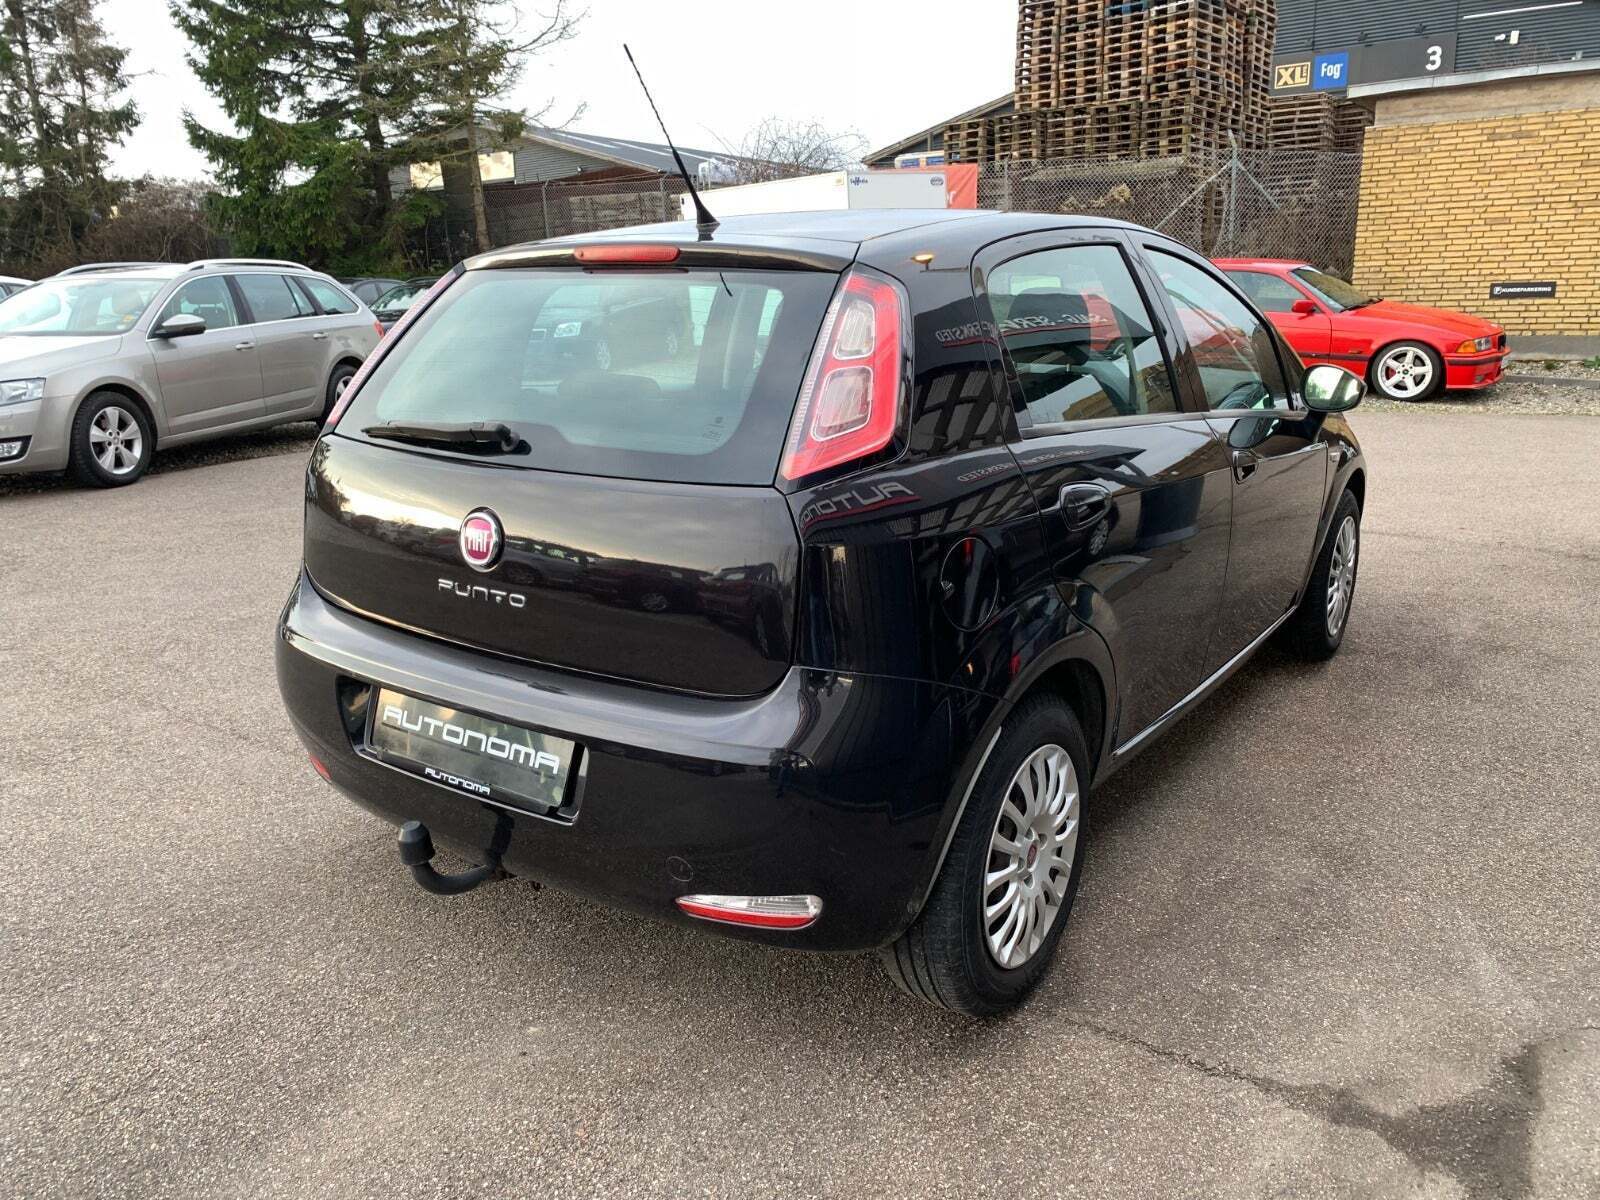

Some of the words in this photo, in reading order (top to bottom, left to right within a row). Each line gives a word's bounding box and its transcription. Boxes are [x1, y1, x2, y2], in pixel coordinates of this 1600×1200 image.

[1321, 62, 1342, 79] Fog
[1425, 45, 1442, 71] 3
[465, 527, 491, 553] FIAT
[437, 578, 527, 608] PUNTO
[382, 704, 561, 775] AUTONOMA
[424, 766, 492, 796] AUTONOMA
